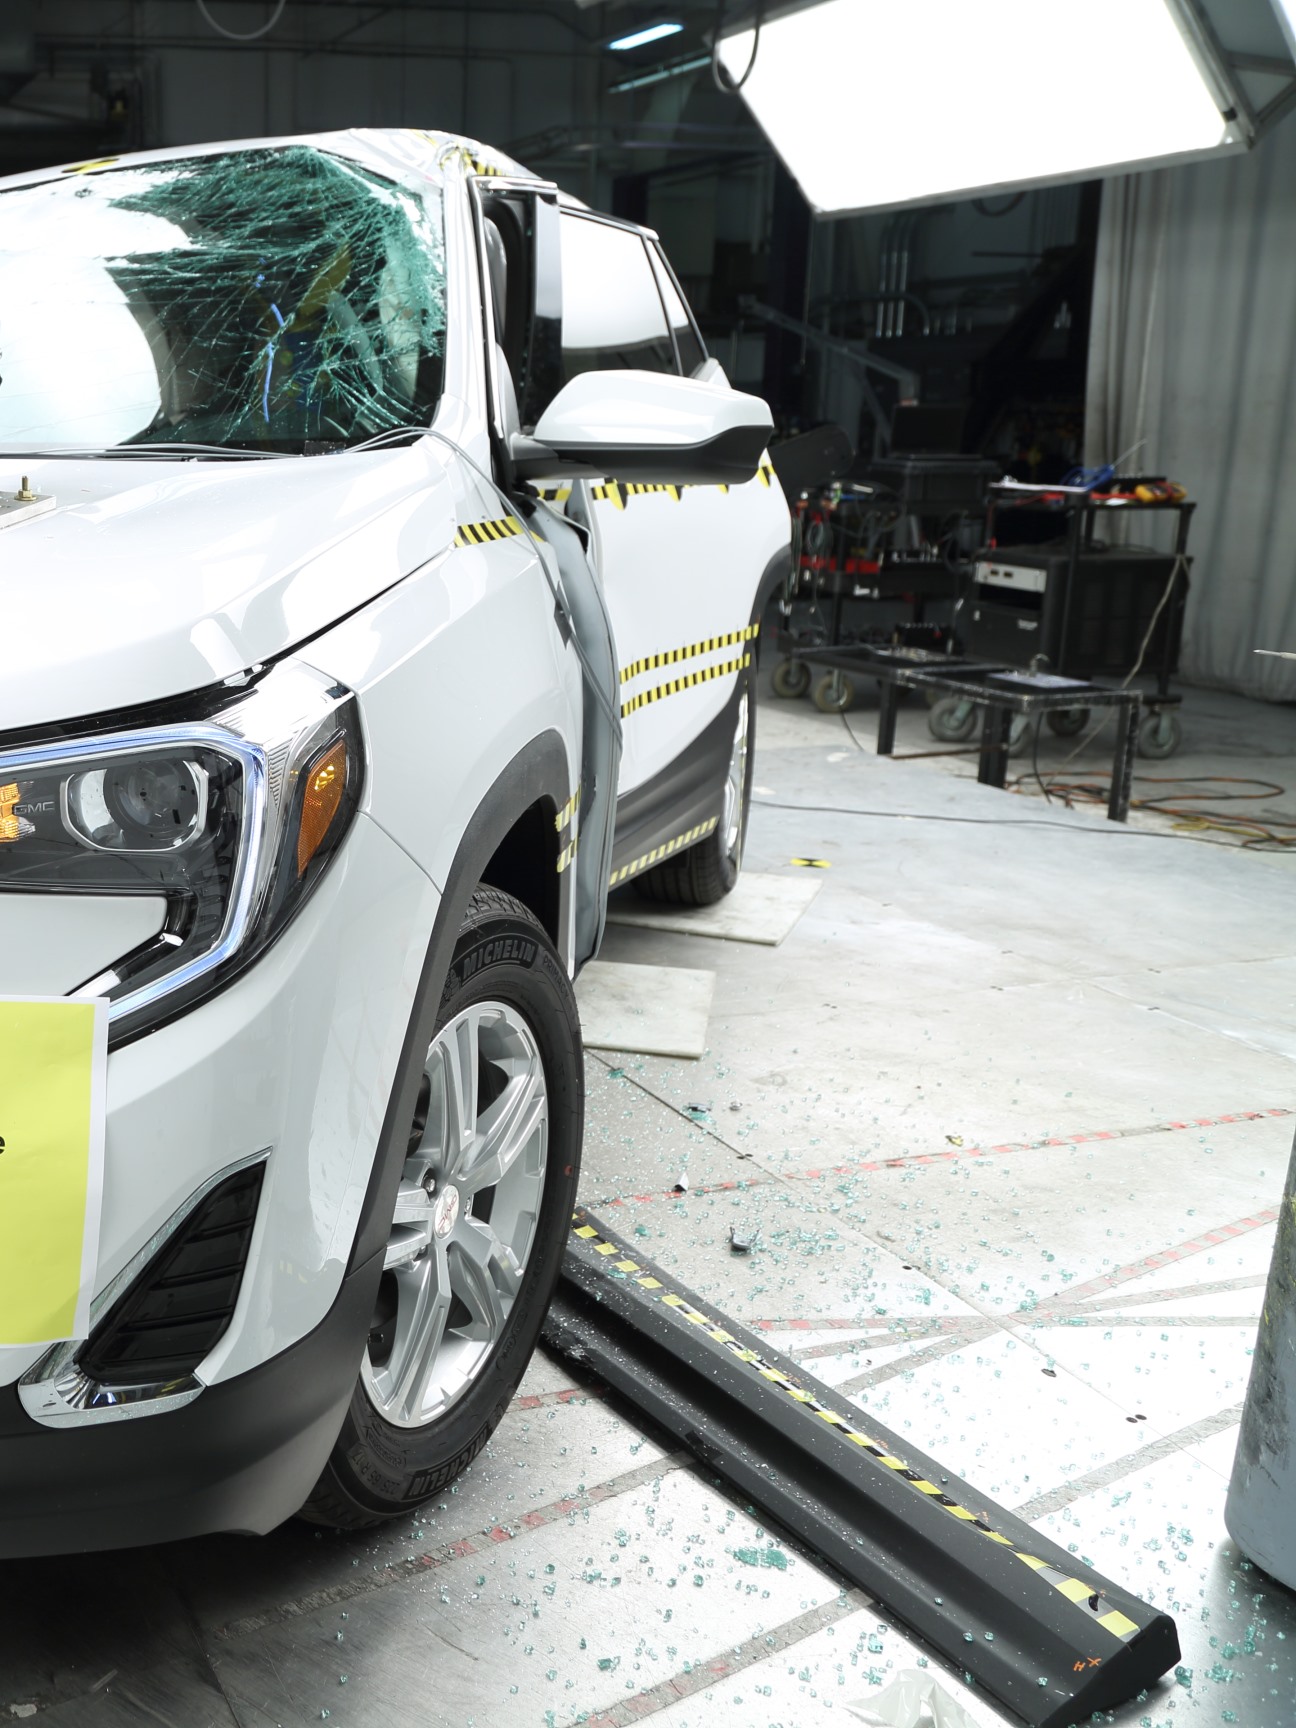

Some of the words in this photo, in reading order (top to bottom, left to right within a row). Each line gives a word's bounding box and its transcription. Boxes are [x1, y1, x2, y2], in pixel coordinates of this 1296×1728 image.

[14, 801, 55, 815] GMC
[462, 939, 537, 980] MICHELIN
[542, 954, 570, 999] PRIMACY
[408, 1430, 488, 1496] MICHELIN
